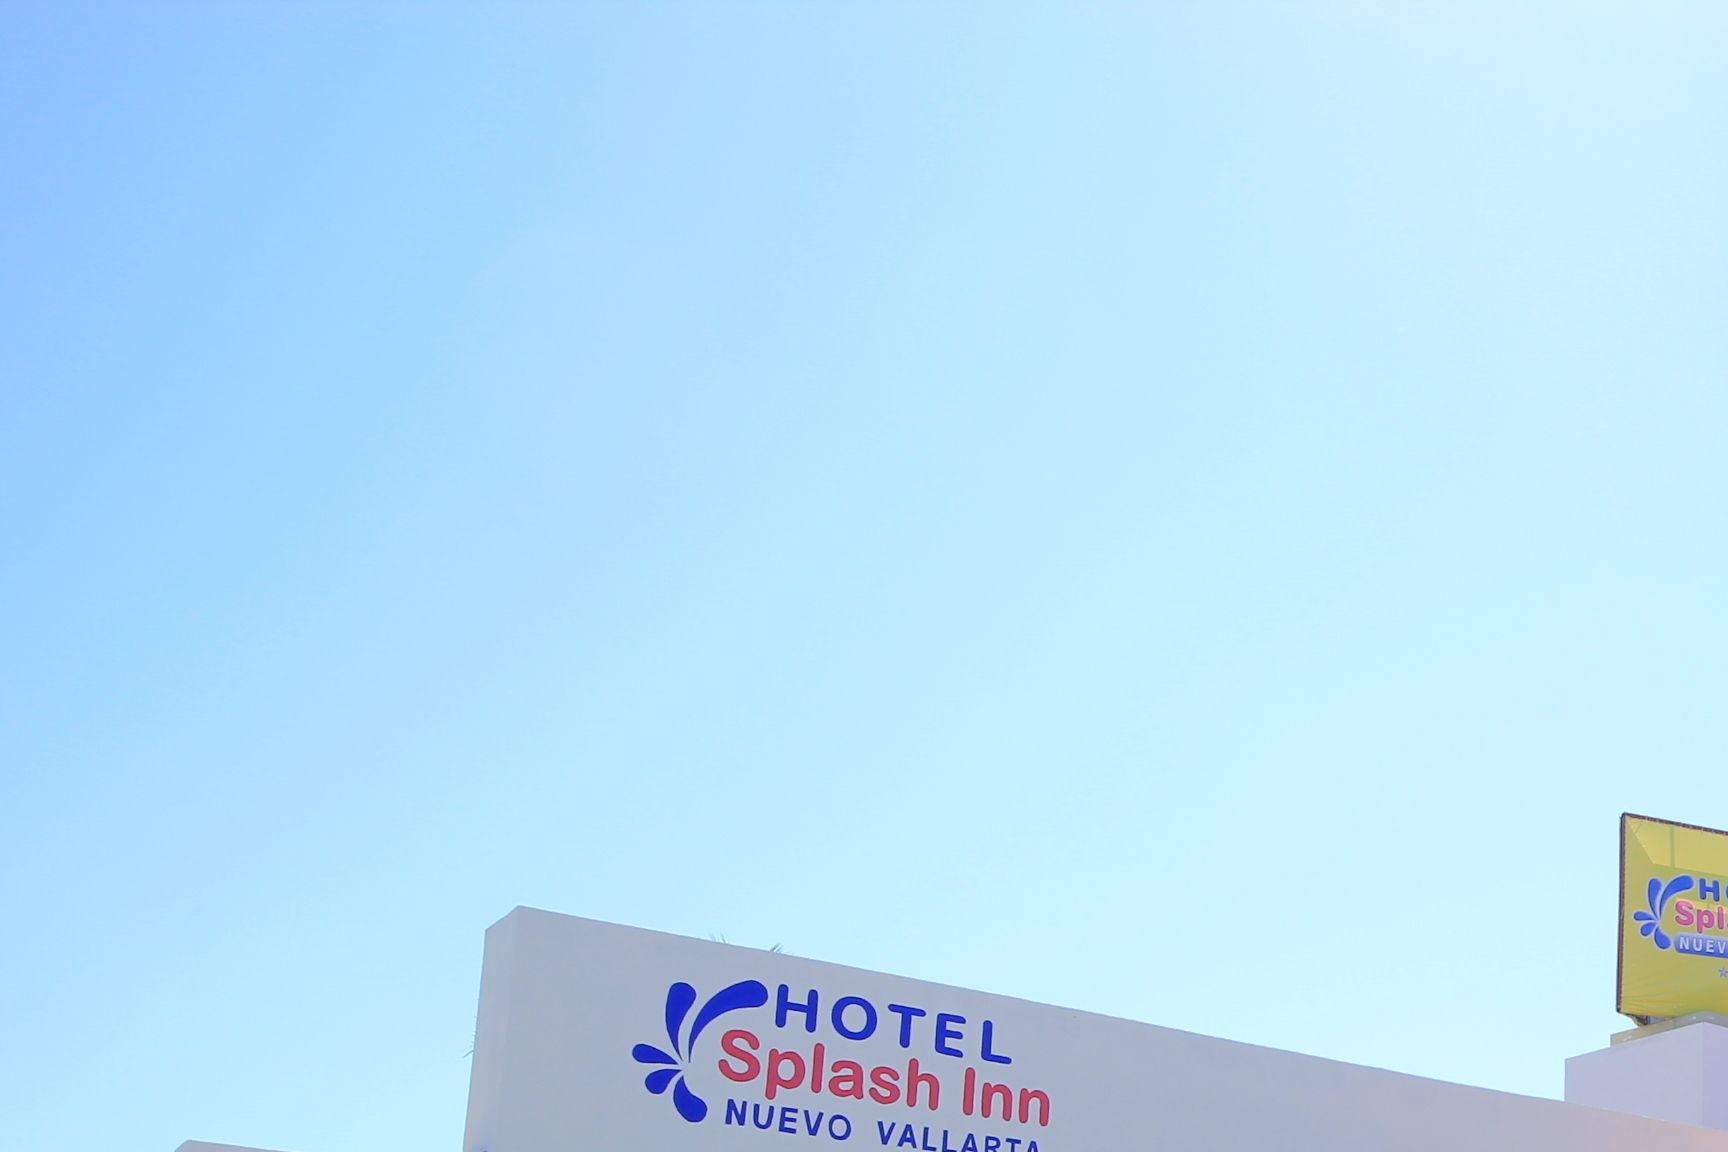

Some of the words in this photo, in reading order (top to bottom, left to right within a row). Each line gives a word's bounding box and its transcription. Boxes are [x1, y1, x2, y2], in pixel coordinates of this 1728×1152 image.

[774, 983, 1012, 1065] HOTEL
[718, 1029, 940, 1111] Splash
[962, 1067, 1051, 1127] Inn
[724, 1098, 852, 1141] NUEVO
